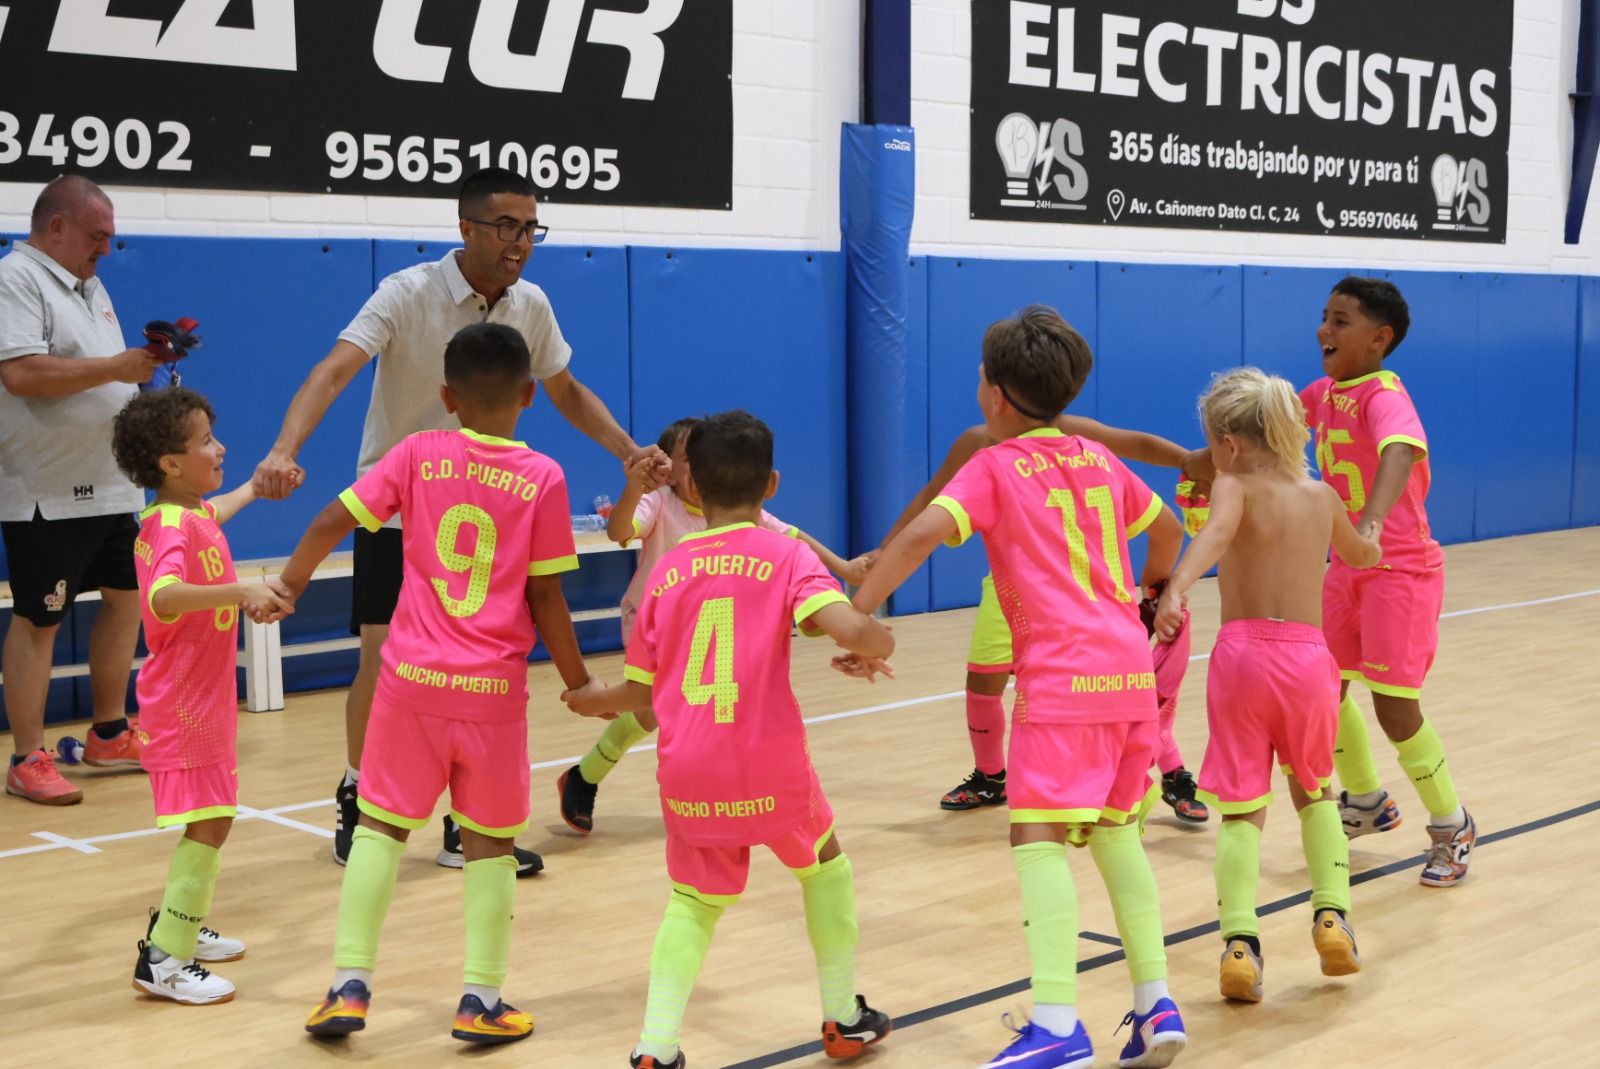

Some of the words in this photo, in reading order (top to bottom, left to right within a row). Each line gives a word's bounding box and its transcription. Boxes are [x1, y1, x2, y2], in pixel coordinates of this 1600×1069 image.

[1008, 0, 1498, 138] ELECTRICISTAS
[325, 131, 621, 191] 956510695
[1109, 130, 1154, 163] 365
[1159, 133, 1201, 167] días
[1206, 140, 1309, 179] trabajando
[1313, 155, 1345, 183] por
[1348, 158, 1361, 186] y
[1365, 159, 1402, 187] para
[1406, 155, 1419, 184] ti
[1129, 198, 1152, 215] Av.
[1155, 199, 1215, 217] Cañonero
[1218, 203, 1247, 219] Dato
[1268, 206, 1281, 223] C,
[1283, 207, 1300, 223] 24
[1339, 209, 1418, 231] 956970644
[73, 485, 94, 497] HH
[420, 459, 459, 481] C.D.
[466, 462, 538, 502] PUERTO
[430, 503, 498, 618] 9
[1045, 485, 1132, 603] 11
[197, 546, 225, 581] 18
[691, 555, 774, 582] PUERTO
[681, 597, 739, 723] 4
[395, 662, 447, 688] MUCHO
[451, 674, 509, 695] PUERTO
[1072, 675, 1123, 692] MUCHO
[714, 796, 775, 817] PUERTO
